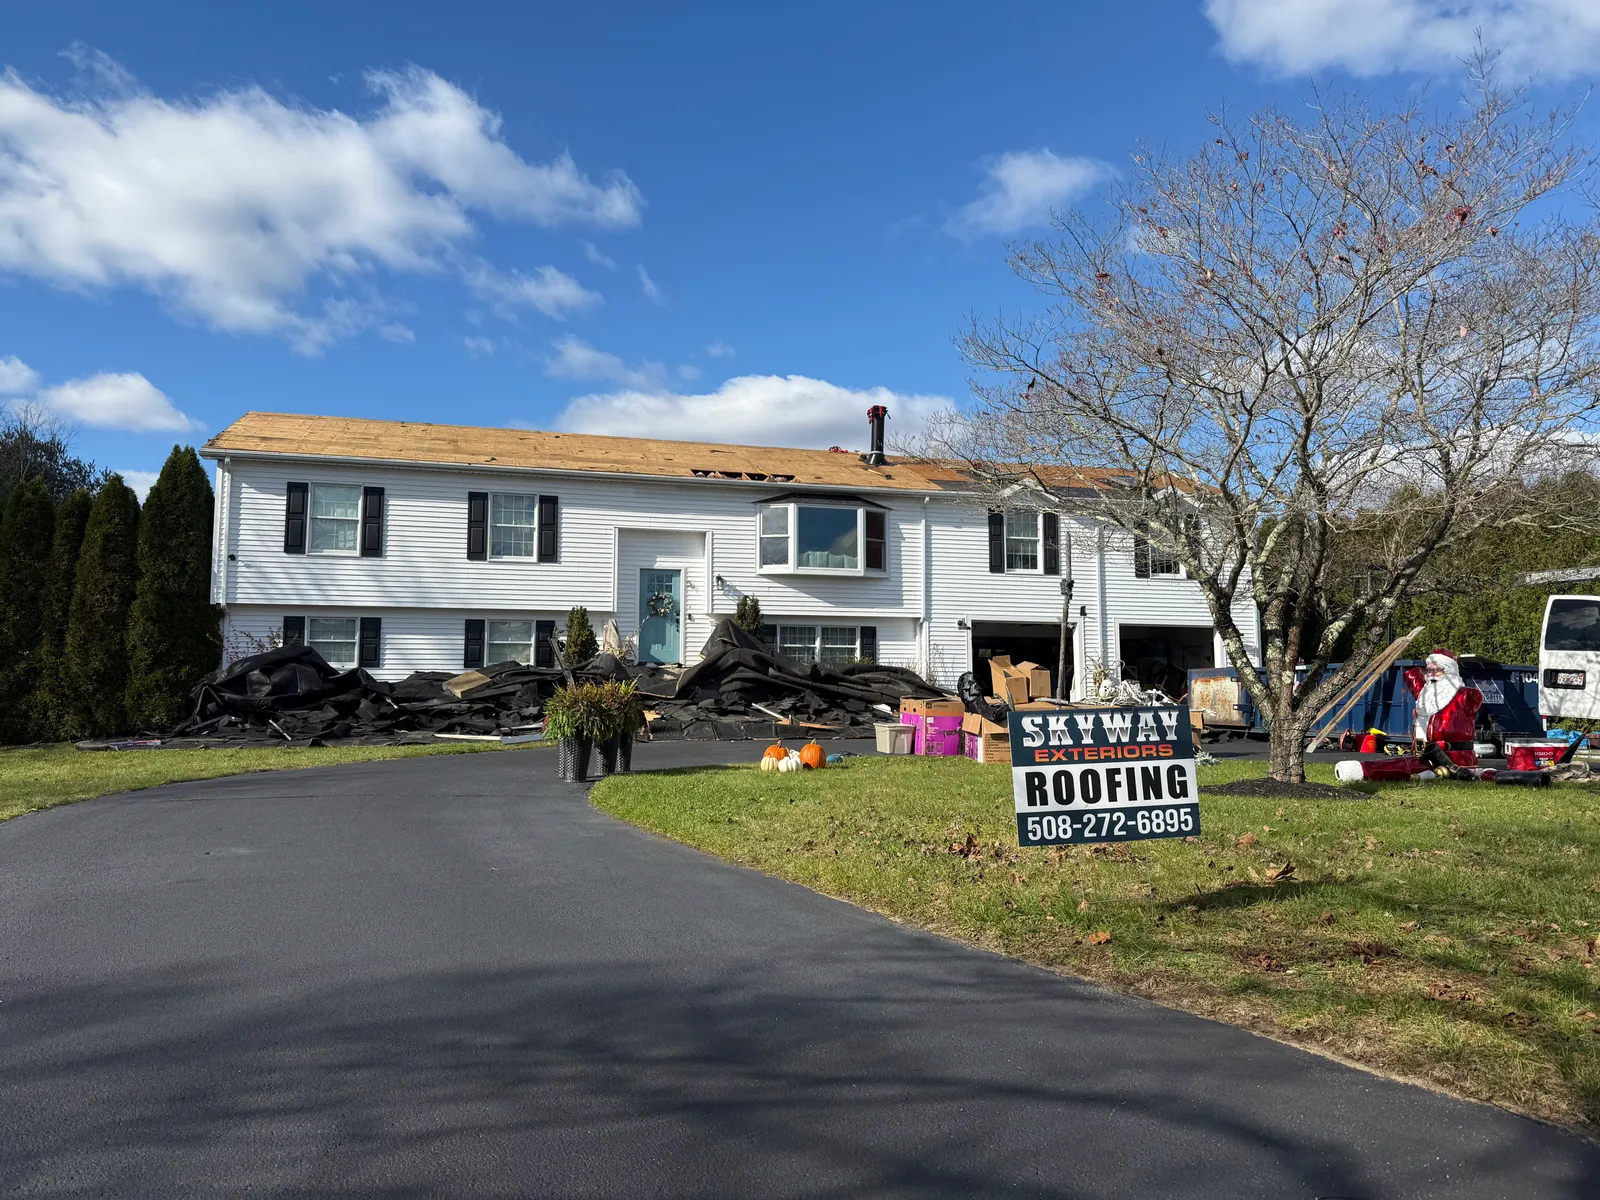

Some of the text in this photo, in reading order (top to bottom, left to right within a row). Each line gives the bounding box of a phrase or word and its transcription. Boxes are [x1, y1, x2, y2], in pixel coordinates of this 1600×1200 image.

[1021, 711, 1180, 747] SKYWAY
[1034, 743, 1174, 763] EXTERIORS
[1025, 764, 1189, 807] ROOFING
[1027, 808, 1193, 841] 508-272-6895
